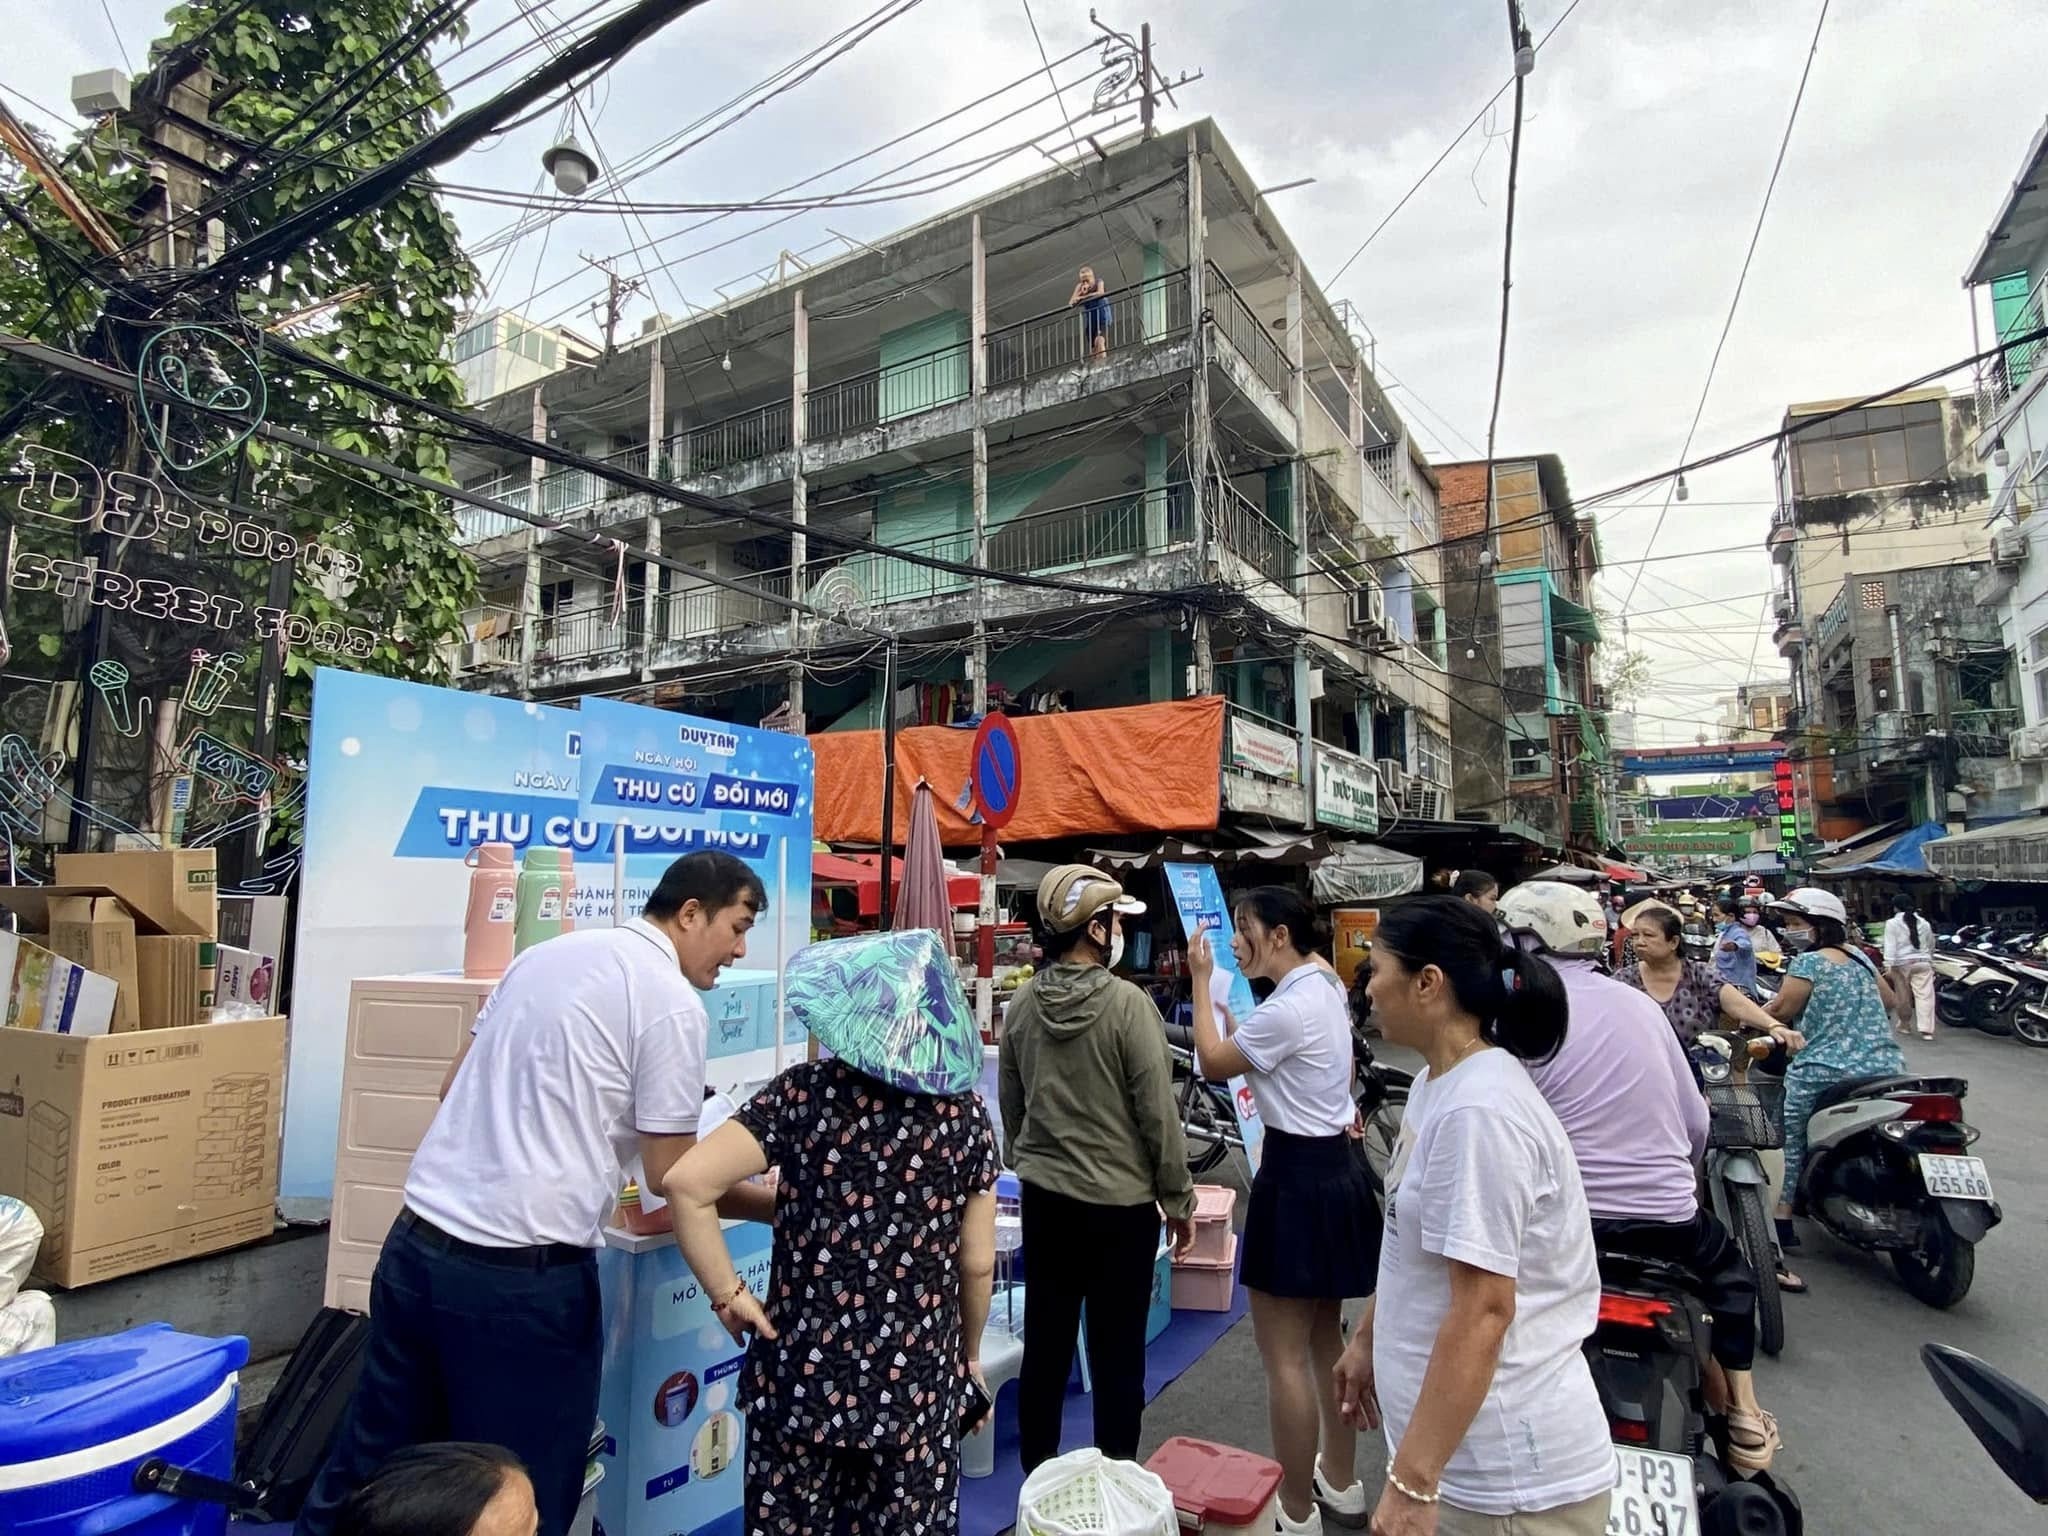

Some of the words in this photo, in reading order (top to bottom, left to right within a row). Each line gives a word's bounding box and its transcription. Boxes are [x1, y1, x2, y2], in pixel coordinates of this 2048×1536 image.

[303, 541, 363, 576] UP
[11, 552, 244, 630] STREET
[254, 606, 377, 660] FOOD
[197, 736, 271, 794] YAY!
[635, 750, 671, 767] NGÀY
[675, 756, 697, 772] HỘI
[514, 769, 571, 791] NGÀY
[613, 776, 661, 803] THU
[668, 781, 696, 804] CŨ
[713, 780, 749, 804] ĐỔI
[755, 787, 789, 809] MỚI
[439, 807, 532, 846] THU
[575, 886, 615, 900] HÀNH
[622, 886, 651, 900] TRÌN
[102, 1096, 138, 1110] PRODUCT
[139, 1089, 191, 1103] INFORMATION
[97, 1160, 121, 1171] COLOR
[672, 1282, 698, 1304] MỞ
[1603, 1347, 1640, 1359] HONDA
